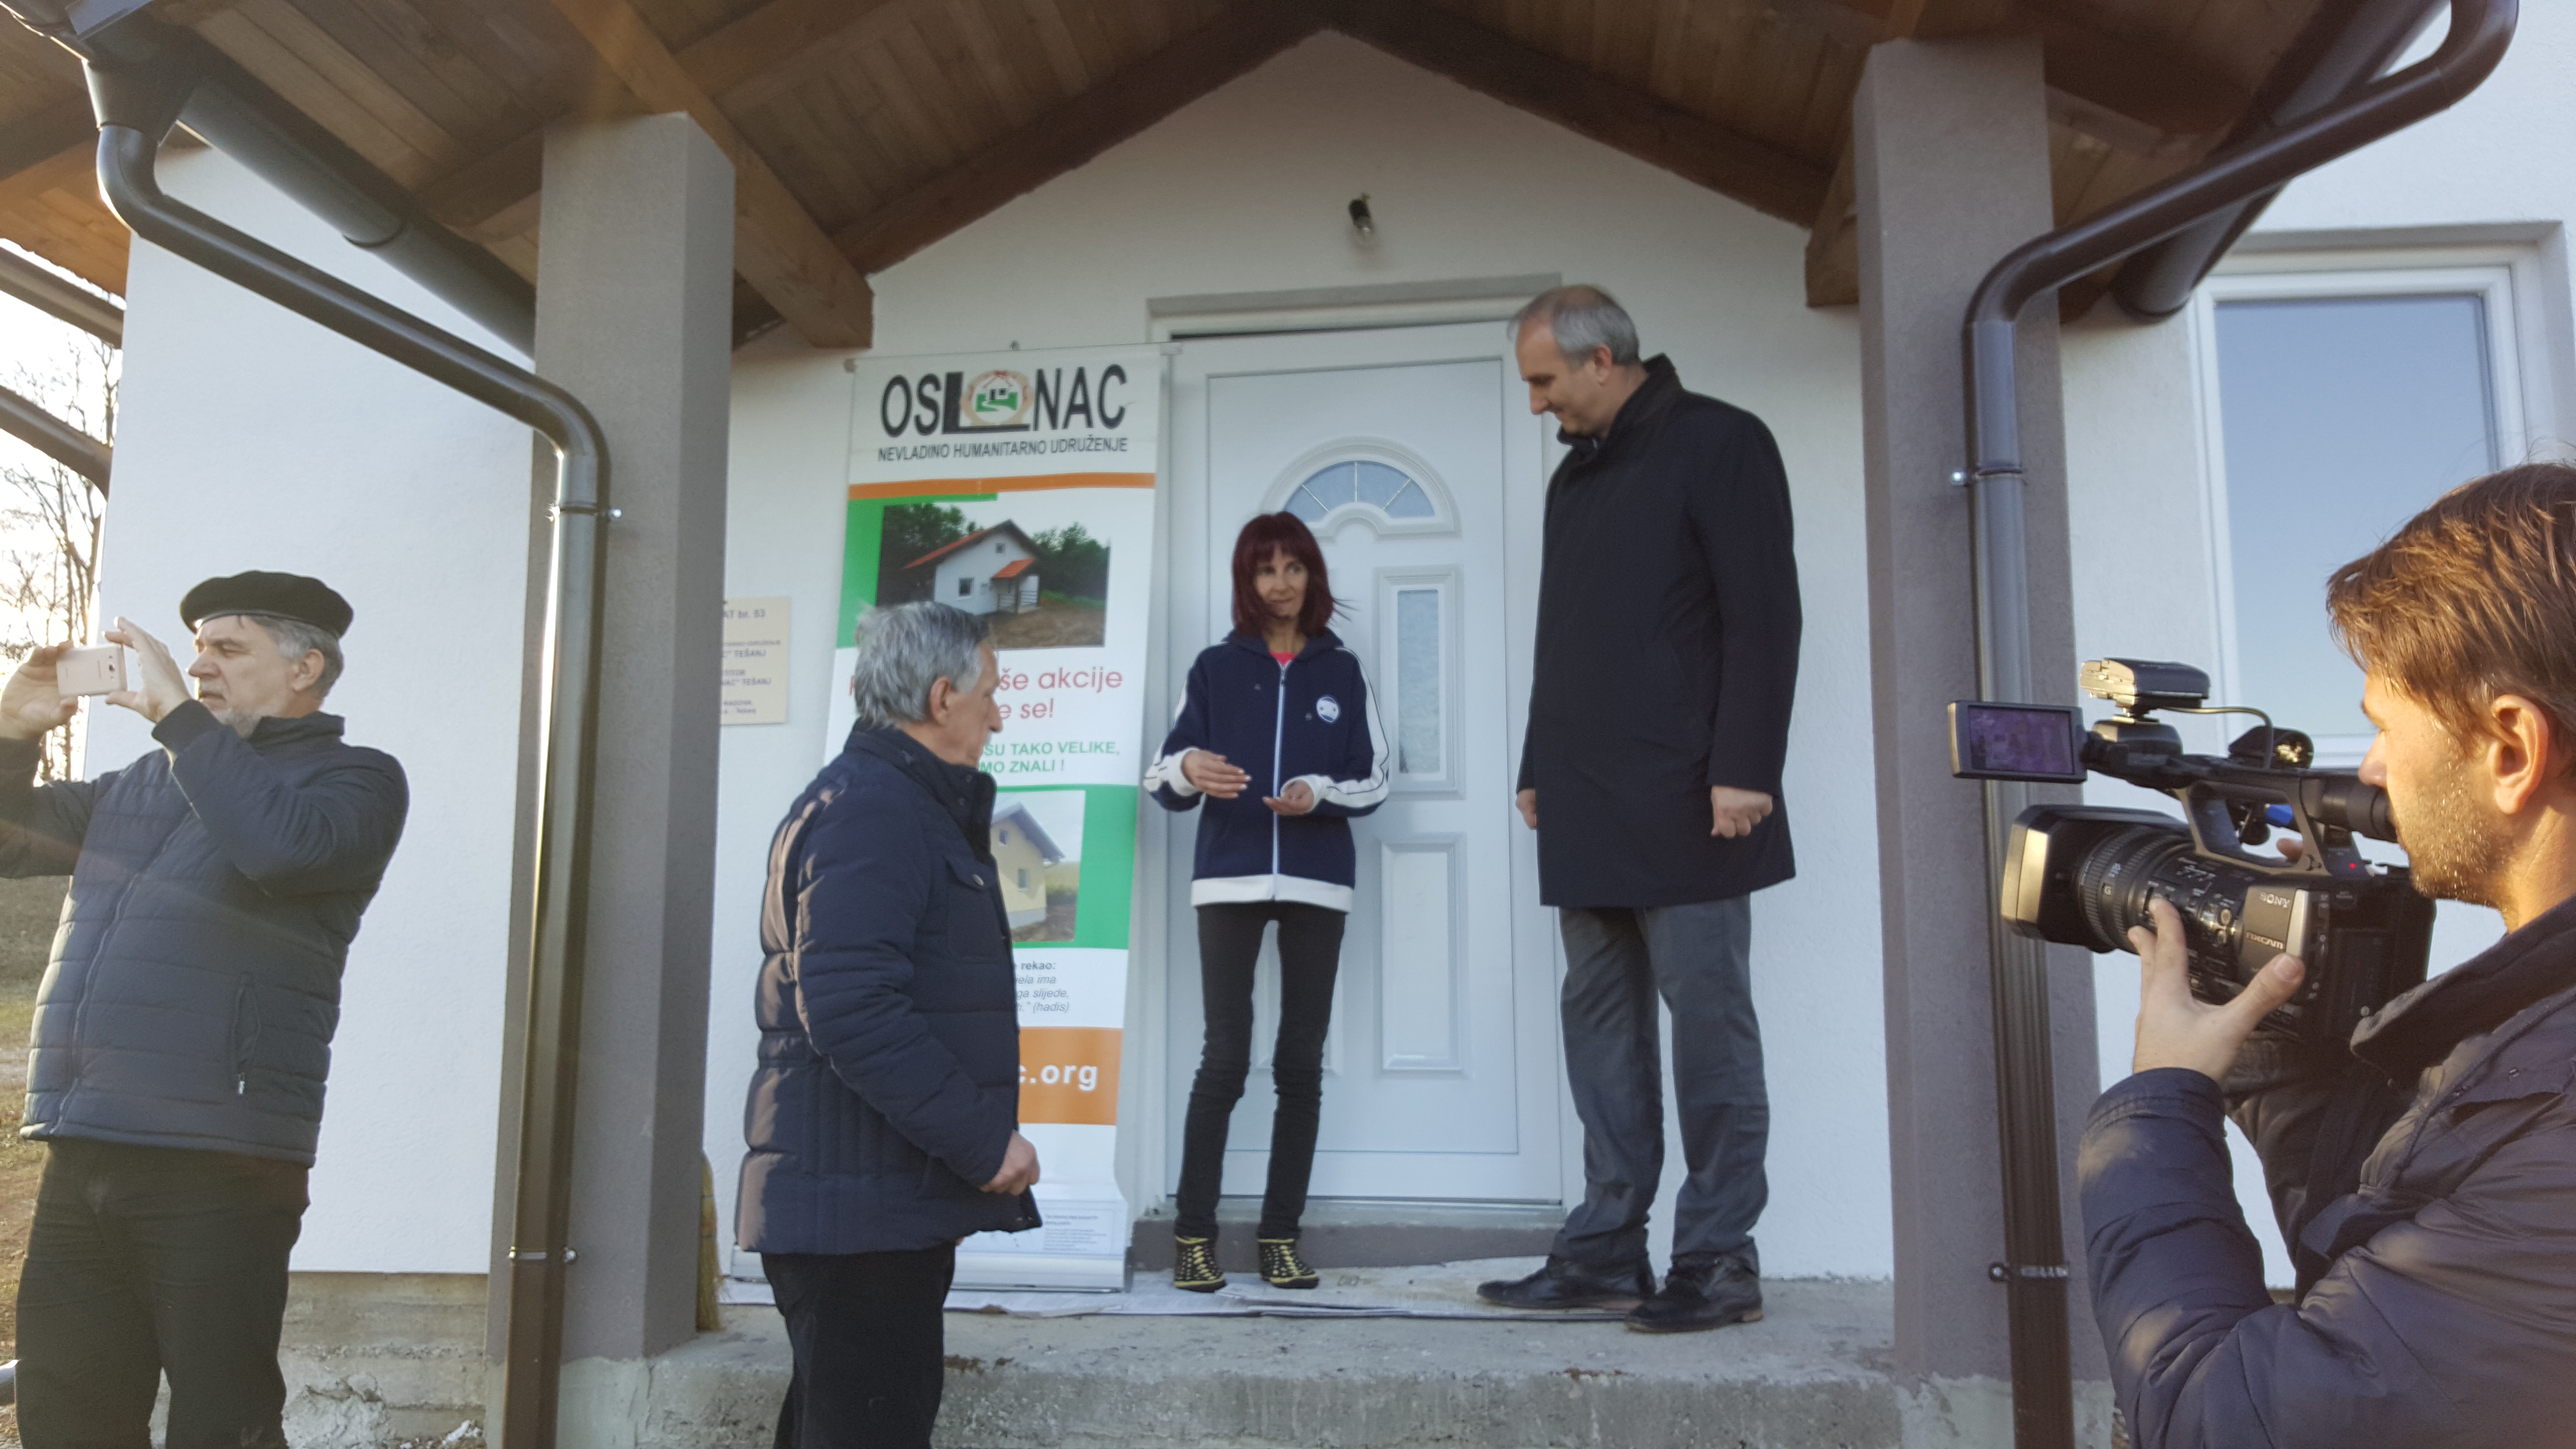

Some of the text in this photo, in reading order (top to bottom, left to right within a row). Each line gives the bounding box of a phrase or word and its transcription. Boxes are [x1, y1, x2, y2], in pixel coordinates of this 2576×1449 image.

[877, 434, 1128, 462] NEVLADINO HUMANITARNO UDRUŽENJE
[998, 666, 1123, 694] še akcije
[1020, 697, 1054, 719] se!
[983, 741, 1120, 756] SU TAKO VELIKE,
[980, 761, 1005, 773] MO
[1009, 759, 1055, 773] ZNALI
[2260, 891, 2291, 908] SONY
[1021, 961, 1056, 970] rekao:
[1037, 975, 1056, 984] ima
[1033, 989, 1069, 1000] slijede.
[1033, 1002, 1069, 1014] (hadis)
